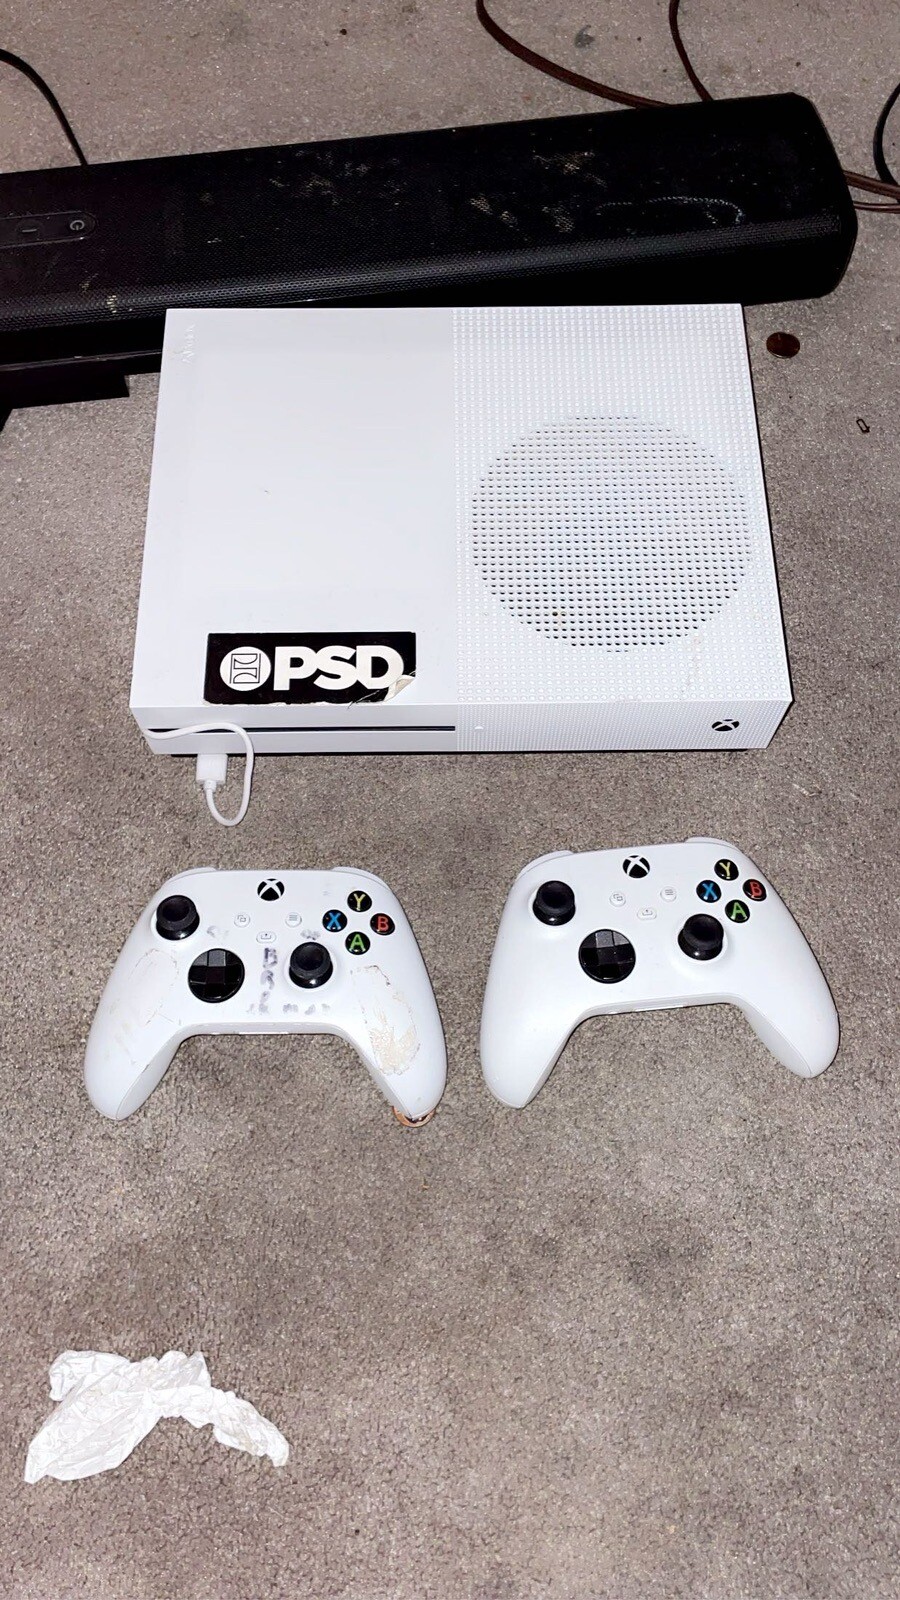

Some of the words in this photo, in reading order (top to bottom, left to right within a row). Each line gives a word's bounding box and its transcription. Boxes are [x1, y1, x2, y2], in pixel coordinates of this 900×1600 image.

[274, 645, 404, 691] PSD
[719, 861, 731, 880] Y
[702, 883, 718, 900] X
[750, 881, 763, 898] B
[353, 893, 366, 911] Y
[730, 902, 748, 920] A
[326, 912, 341, 930] X
[376, 915, 389, 932] B
[349, 934, 366, 952] A
